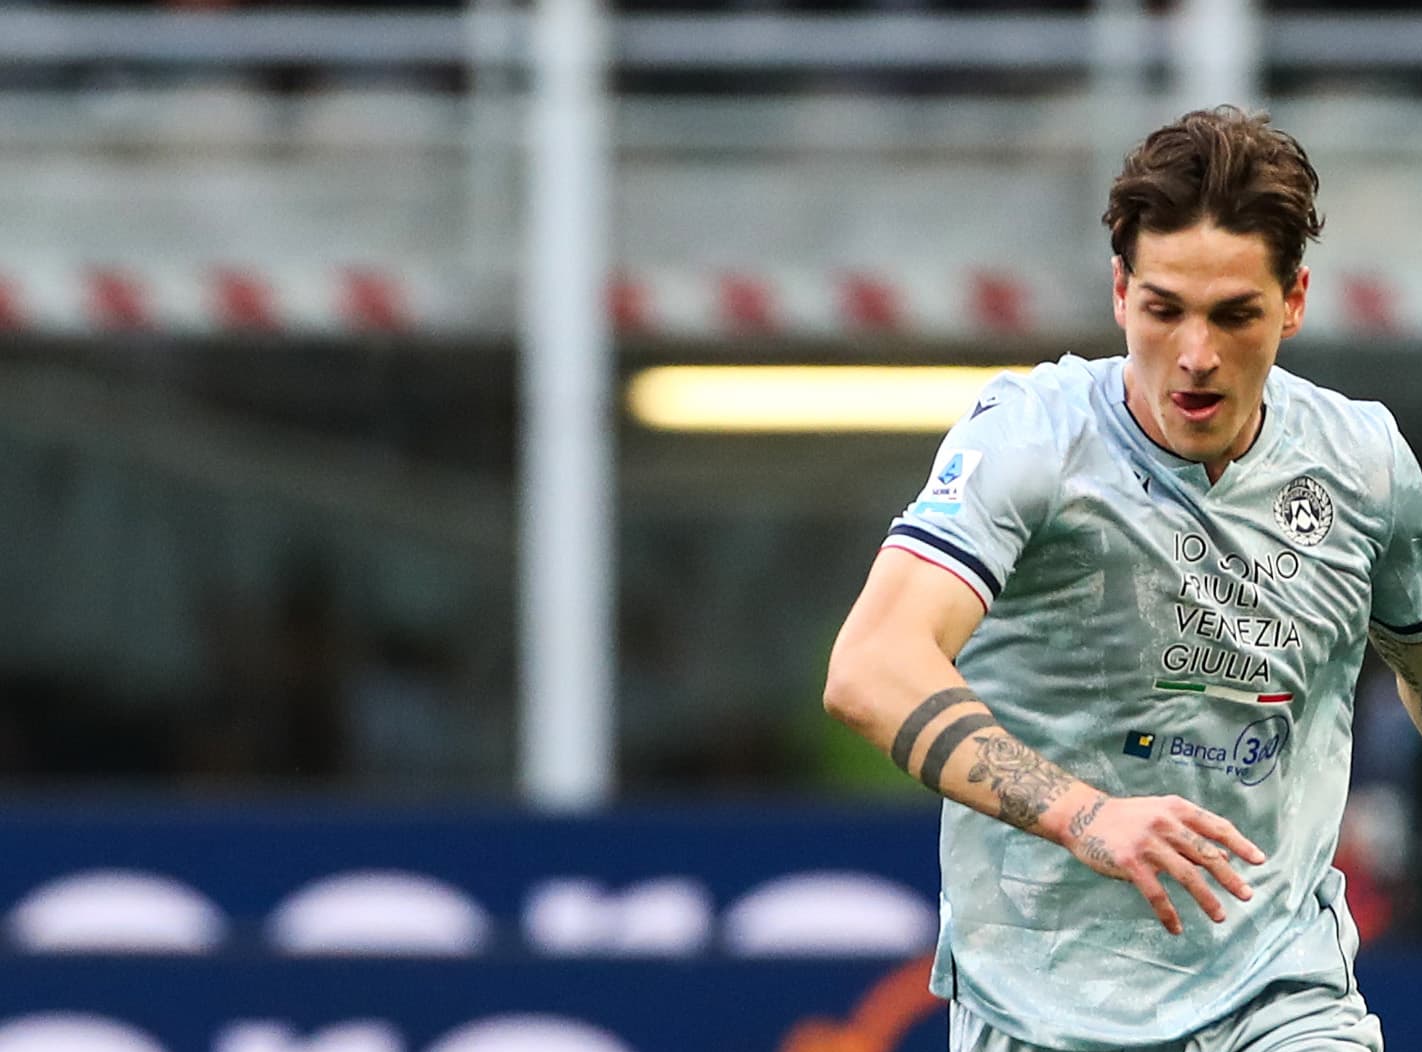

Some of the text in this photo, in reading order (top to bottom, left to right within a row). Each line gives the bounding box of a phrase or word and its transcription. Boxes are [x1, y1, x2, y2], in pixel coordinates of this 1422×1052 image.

[1174, 532, 1207, 563] IO
[1176, 605, 1302, 648] VENEZIA
[1163, 644, 1270, 682] GIULIA
[1169, 736, 1227, 761] Banca
